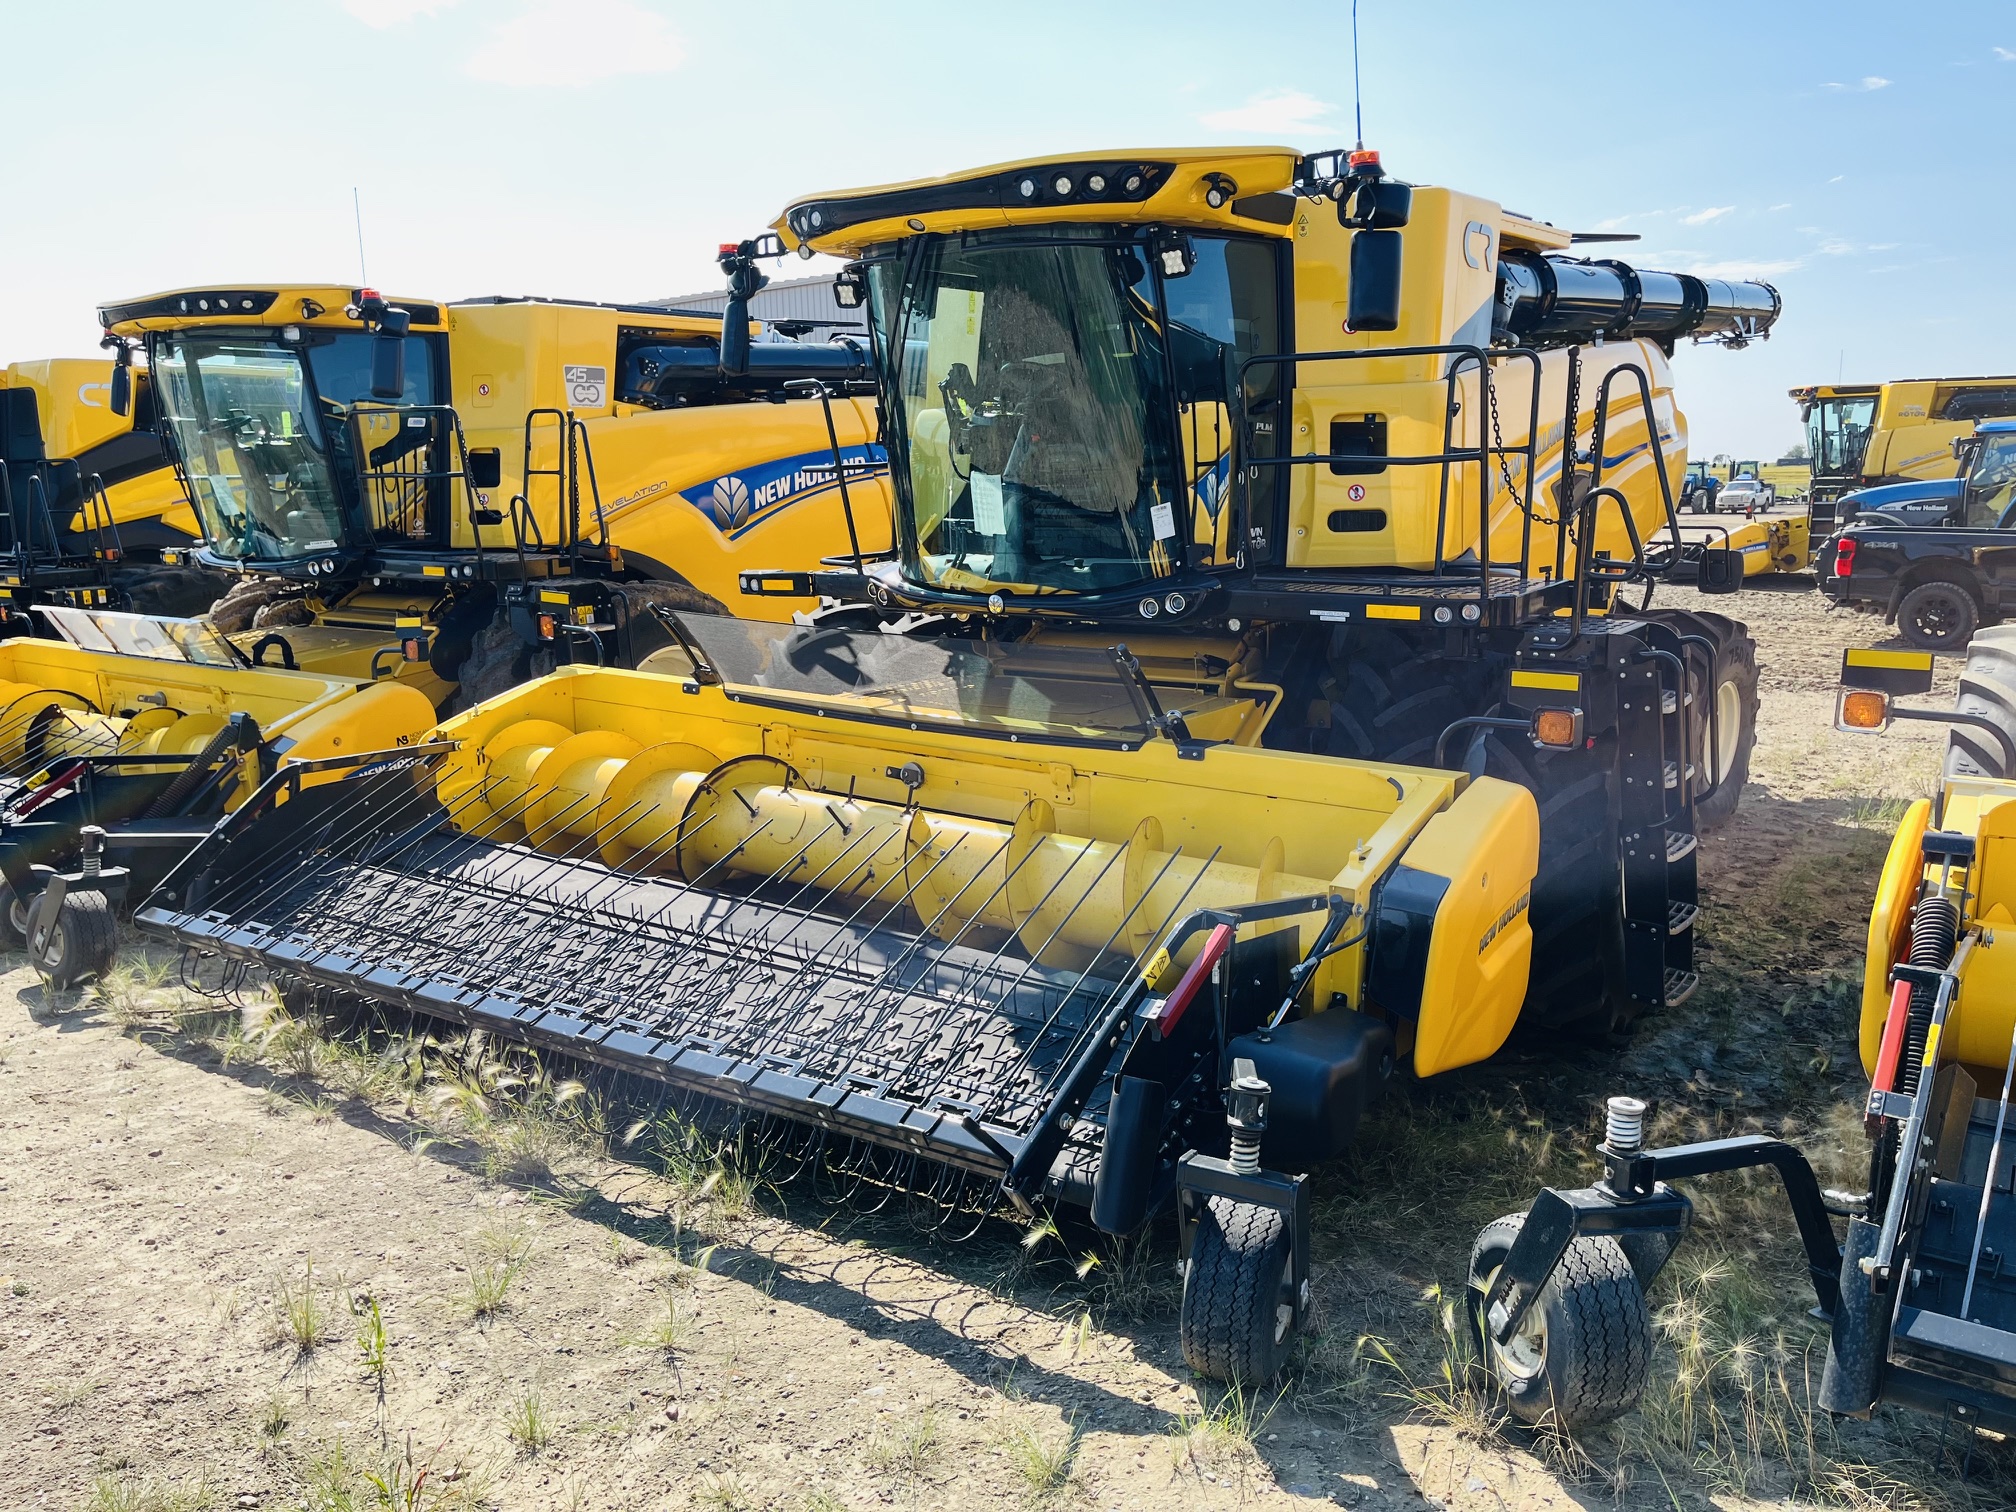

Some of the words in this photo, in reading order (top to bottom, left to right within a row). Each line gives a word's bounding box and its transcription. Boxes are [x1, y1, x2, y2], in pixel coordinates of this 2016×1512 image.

[1463, 220, 1494, 272] CR
[566, 367, 588, 382] 45
[78, 383, 112, 407] C
[1255, 422, 1273, 432] PLM
[754, 474, 792, 510] NEW
[1479, 920, 1499, 956] NEW
[1498, 892, 1529, 934] HOLLAND
